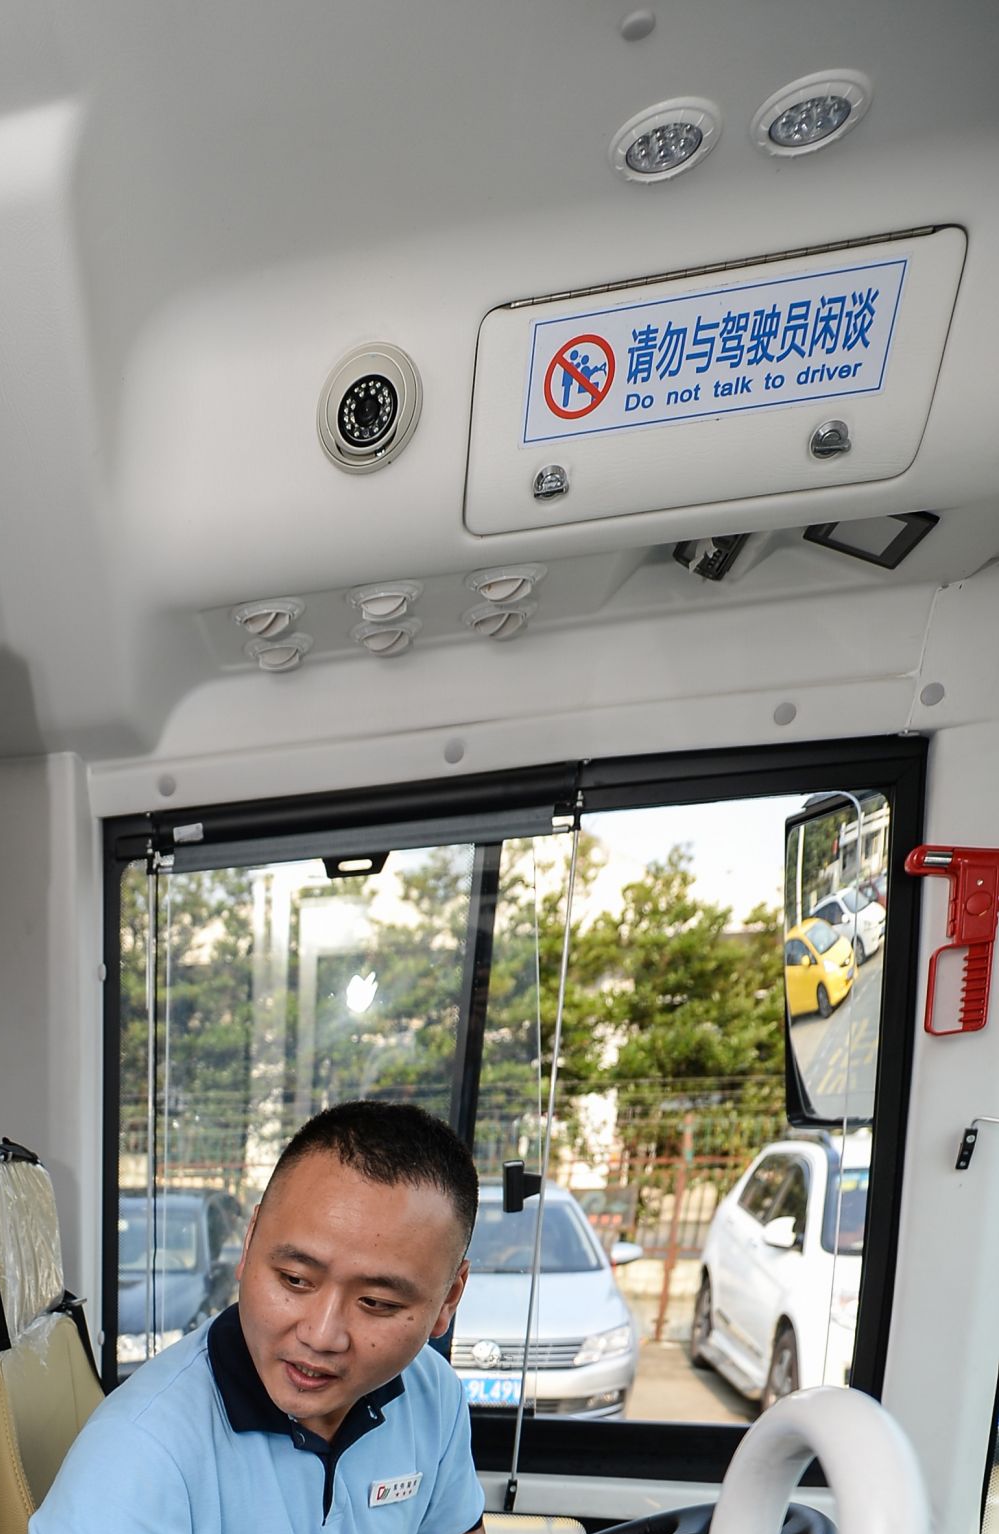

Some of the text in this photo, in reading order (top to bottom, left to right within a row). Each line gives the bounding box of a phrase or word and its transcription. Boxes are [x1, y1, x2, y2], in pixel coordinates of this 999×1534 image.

[627, 288, 879, 384] 请勿与驾驶员闲谈
[625, 359, 862, 411] Do not talk to driver
